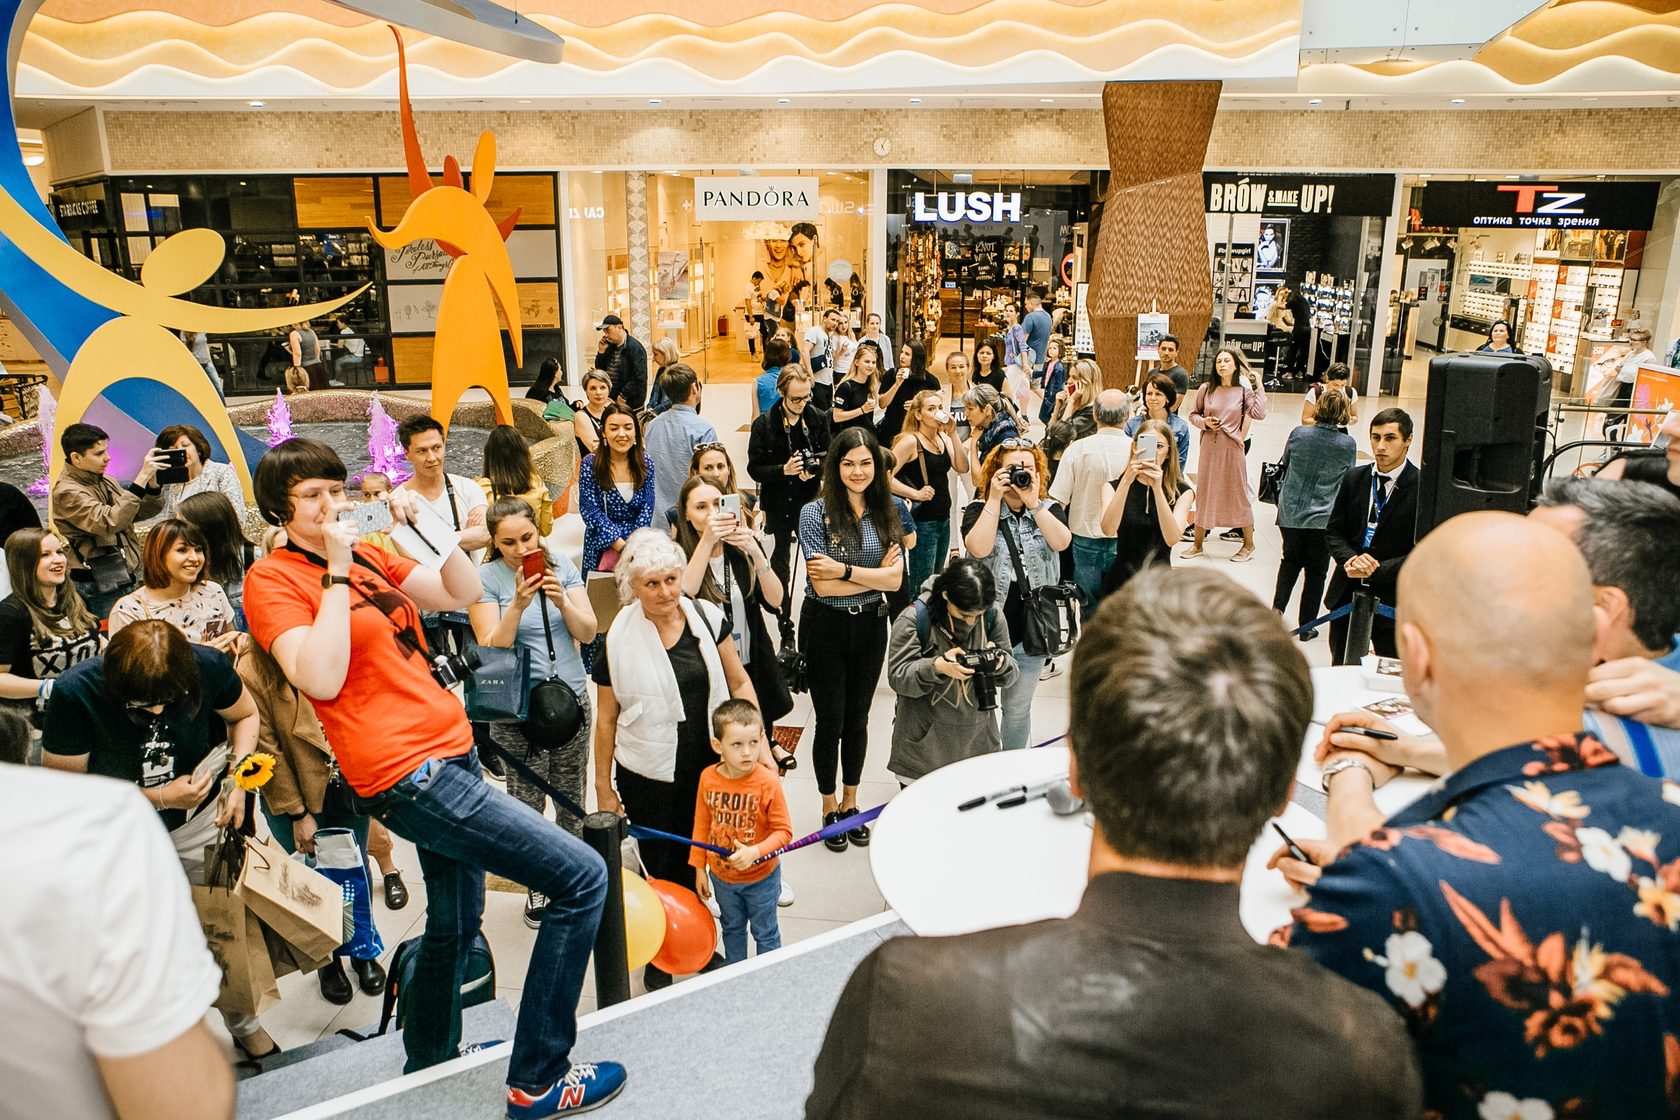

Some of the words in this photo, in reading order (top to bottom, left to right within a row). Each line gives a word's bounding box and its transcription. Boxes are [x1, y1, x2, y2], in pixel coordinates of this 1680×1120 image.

[704, 187, 809, 207] PANDORA
[1209, 177, 1267, 212] BRÓW
[1301, 184, 1335, 214] UP!
[914, 191, 1021, 223] LUSH
[1473, 215, 1513, 225] оптика
[1519, 216, 1551, 226] точка
[1557, 217, 1600, 227] зрения
[706, 790, 760, 811] HEROIC
